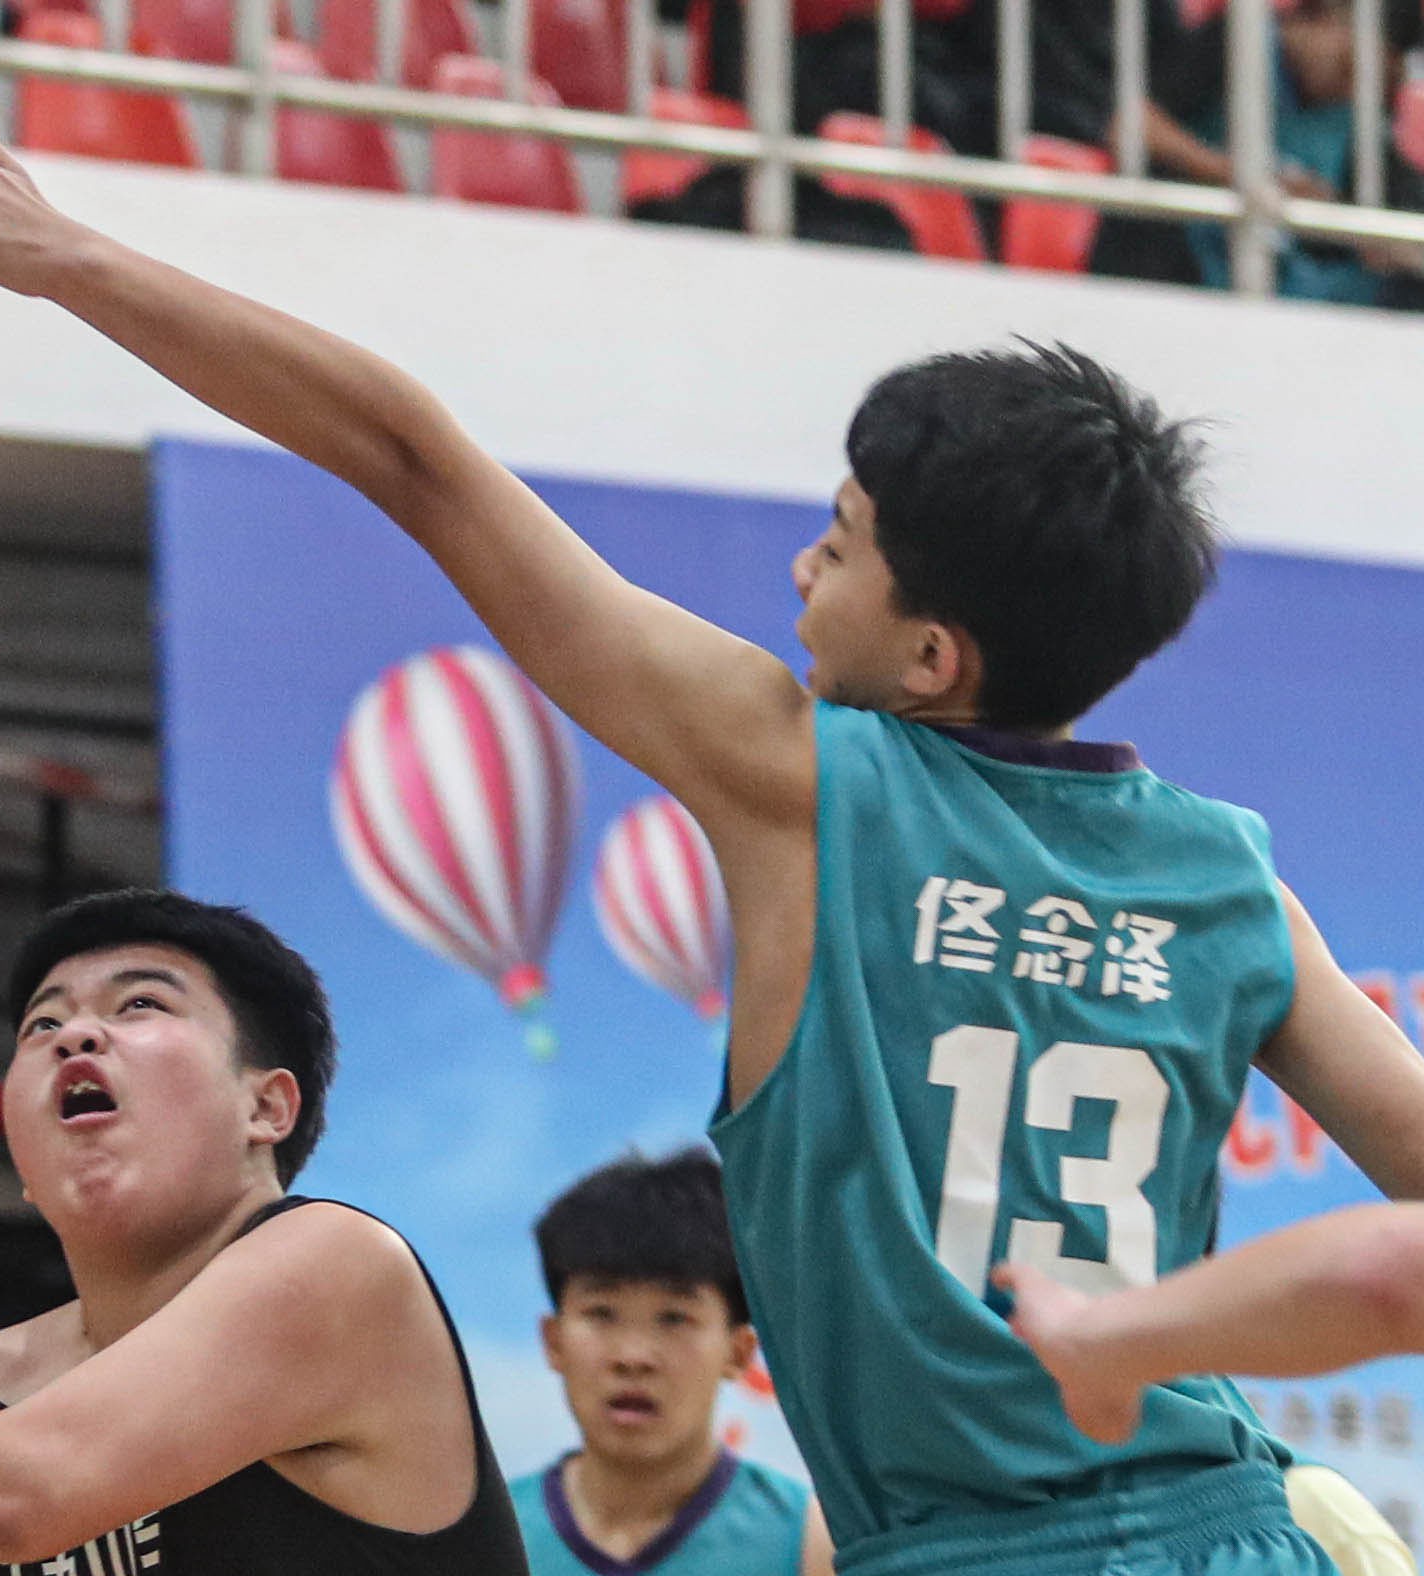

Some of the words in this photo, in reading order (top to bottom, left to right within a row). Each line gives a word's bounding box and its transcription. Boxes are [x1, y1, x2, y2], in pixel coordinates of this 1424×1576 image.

[912, 875, 1178, 1003] 佟念泽
[926, 1024, 1171, 1302] 13
